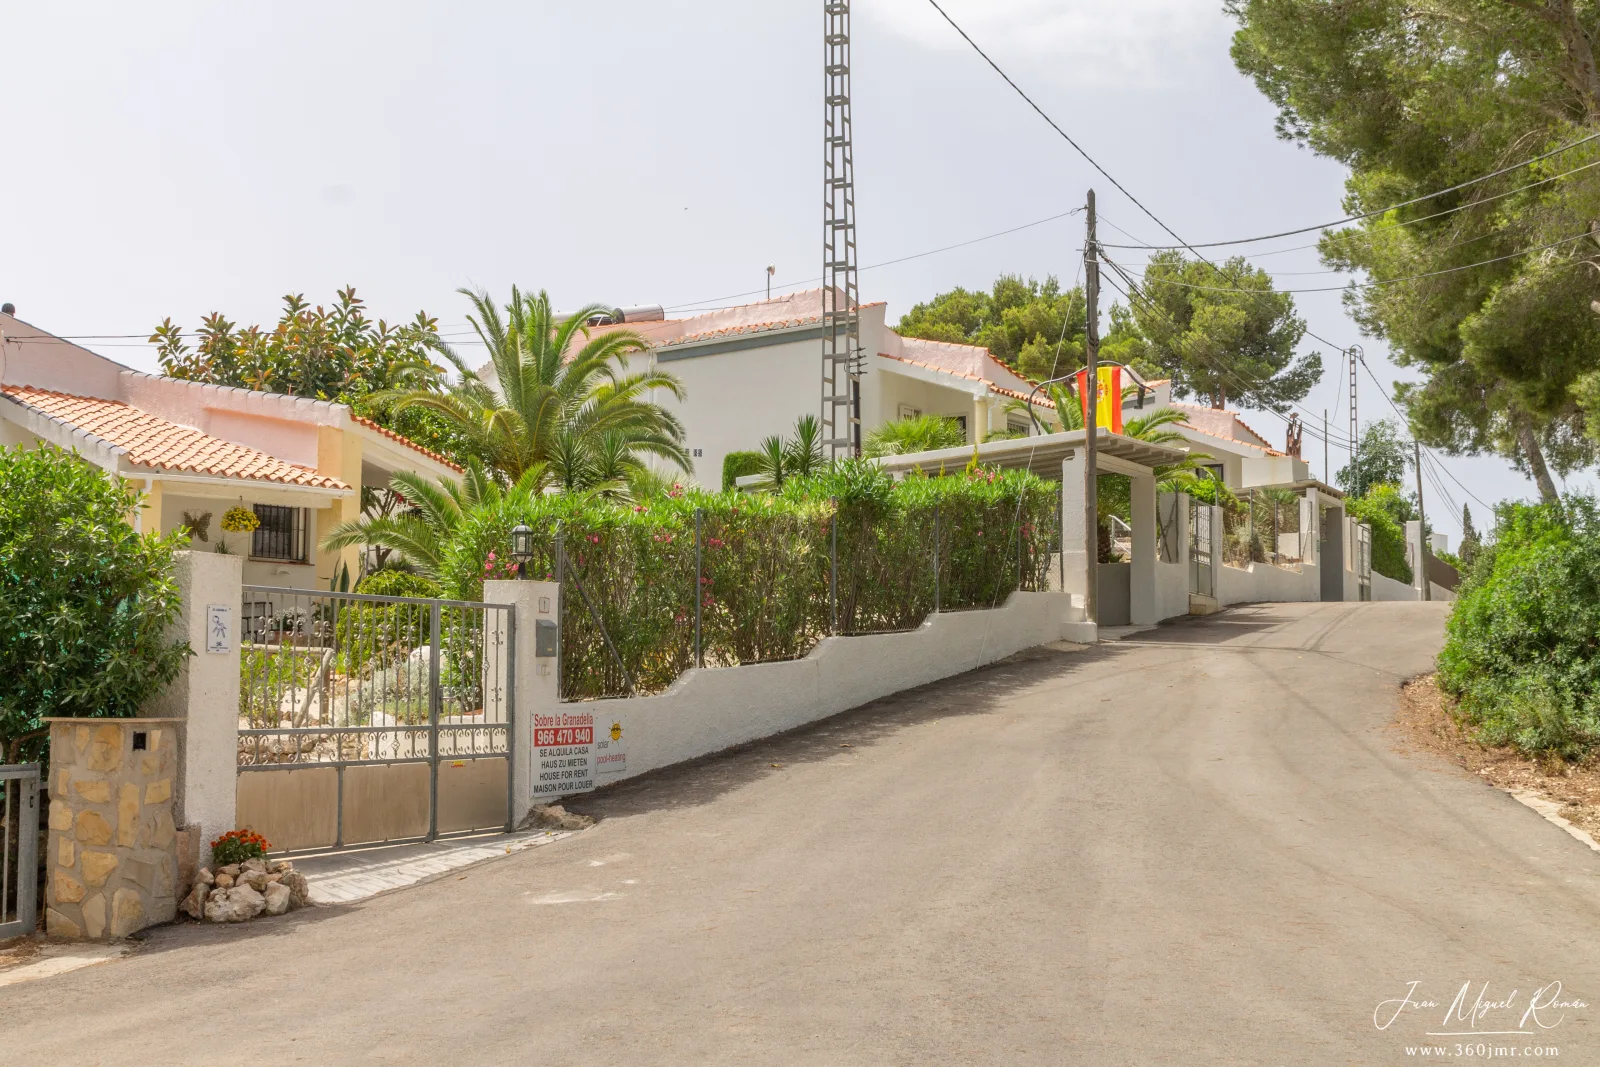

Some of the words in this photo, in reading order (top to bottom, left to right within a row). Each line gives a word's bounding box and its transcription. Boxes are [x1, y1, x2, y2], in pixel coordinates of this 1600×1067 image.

[534, 713, 554, 727] Sobre
[555, 713, 561, 726] la
[562, 712, 593, 726] Granadella
[537, 729, 555, 745] 966
[556, 729, 573, 744] 470
[575, 728, 591, 743] 940
[597, 740, 609, 749] solar
[539, 748, 548, 758] SE
[548, 747, 573, 757] ALQUILA
[573, 746, 589, 755] CASA
[541, 760, 558, 769] HAUS
[558, 759, 567, 768] ZU
[567, 757, 588, 767] MIETEN
[596, 753, 626, 766] pool-heating
[539, 771, 560, 781] HOUSE
[560, 770, 573, 779] FOR
[573, 769, 589, 778] RENT
[533, 783, 557, 793] MAISON
[557, 782, 574, 791] POUR
[574, 780, 593, 790] LOUER
